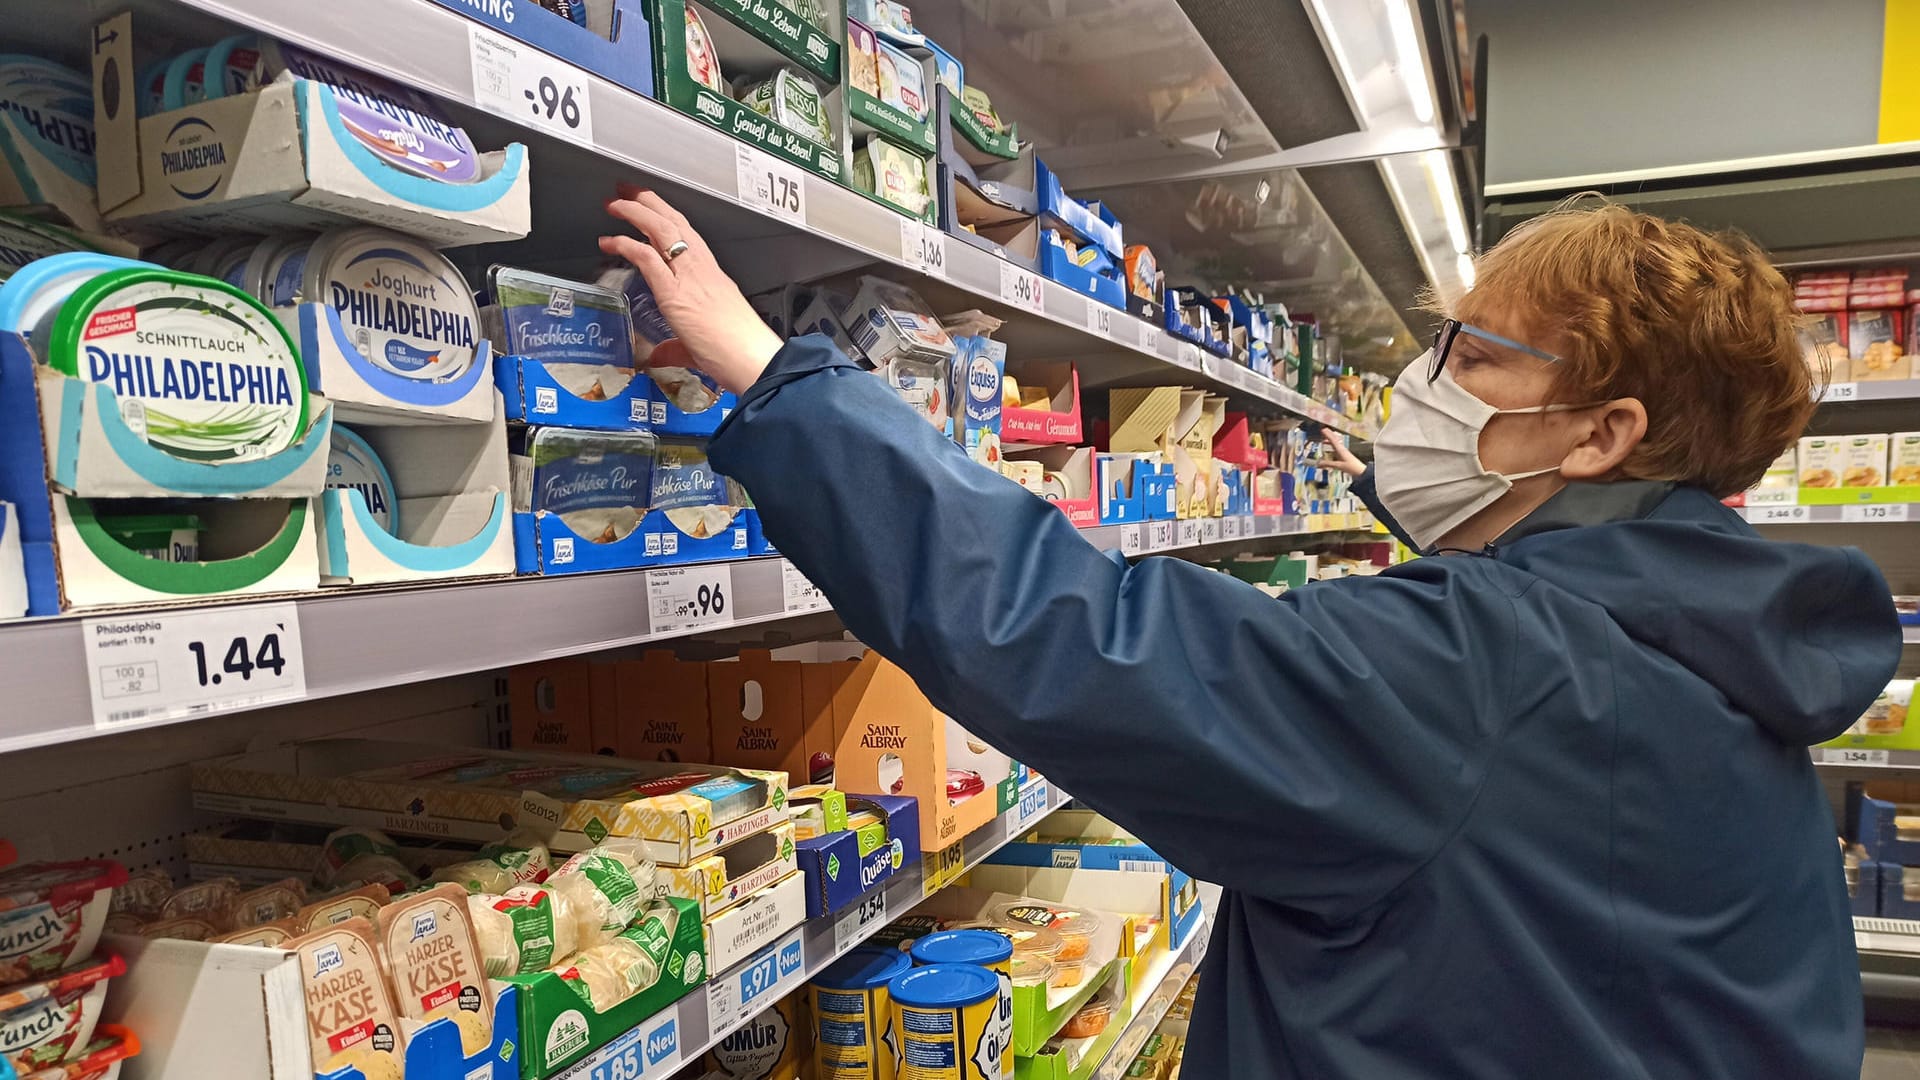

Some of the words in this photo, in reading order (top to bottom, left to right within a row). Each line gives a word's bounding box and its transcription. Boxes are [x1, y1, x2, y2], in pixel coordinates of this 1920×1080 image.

[752, 2, 770, 21] das
[524, 76, 581, 129] -.96
[733, 110, 767, 142] Genieß
[767, 128, 783, 148] das
[783, 133, 813, 162] Leben!
[161, 142, 226, 177] PHILADELPHIA
[768, 171, 800, 213] 1.75
[371, 268, 437, 301] Joghurt
[331, 280, 475, 349] PHILADELPHIA
[136, 331, 246, 354] SCHNITTLAUCH
[518, 320, 585, 351] Frischkäse
[586, 322, 614, 348] Pur
[85, 344, 294, 406] PHILADELPHIA
[610, 465, 638, 491] Pur
[690, 470, 715, 491] Pur
[688, 582, 724, 618] -.96
[96, 621, 162, 636] Philadelphia
[188, 632, 287, 687] 1.44
[532, 731, 569, 745] ALBRAY
[537, 720, 565, 734] SAINT
[642, 730, 686, 745] ALBRAY
[647, 719, 679, 733] SAINT
[742, 725, 773, 740] SAINT
[866, 723, 901, 737] SAINT
[736, 736, 778, 751] ALBRAY
[860, 735, 908, 749] ALBRAY
[384, 815, 451, 835] HARZINGER
[522, 800, 560, 824] 020121
[726, 814, 770, 842] HARZINGER
[862, 850, 892, 886] Quäse
[941, 843, 961, 872] 1.95
[740, 865, 780, 895] HARZINGER
[860, 892, 884, 925] 2.54
[405, 934, 456, 967] HARZER
[782, 949, 800, 971] Neu
[306, 968, 366, 1006] HARZER
[407, 950, 467, 998] KÄSE
[745, 959, 771, 998] -.97
[307, 985, 378, 1040] KÄSE
[650, 1031, 675, 1058] Neu
